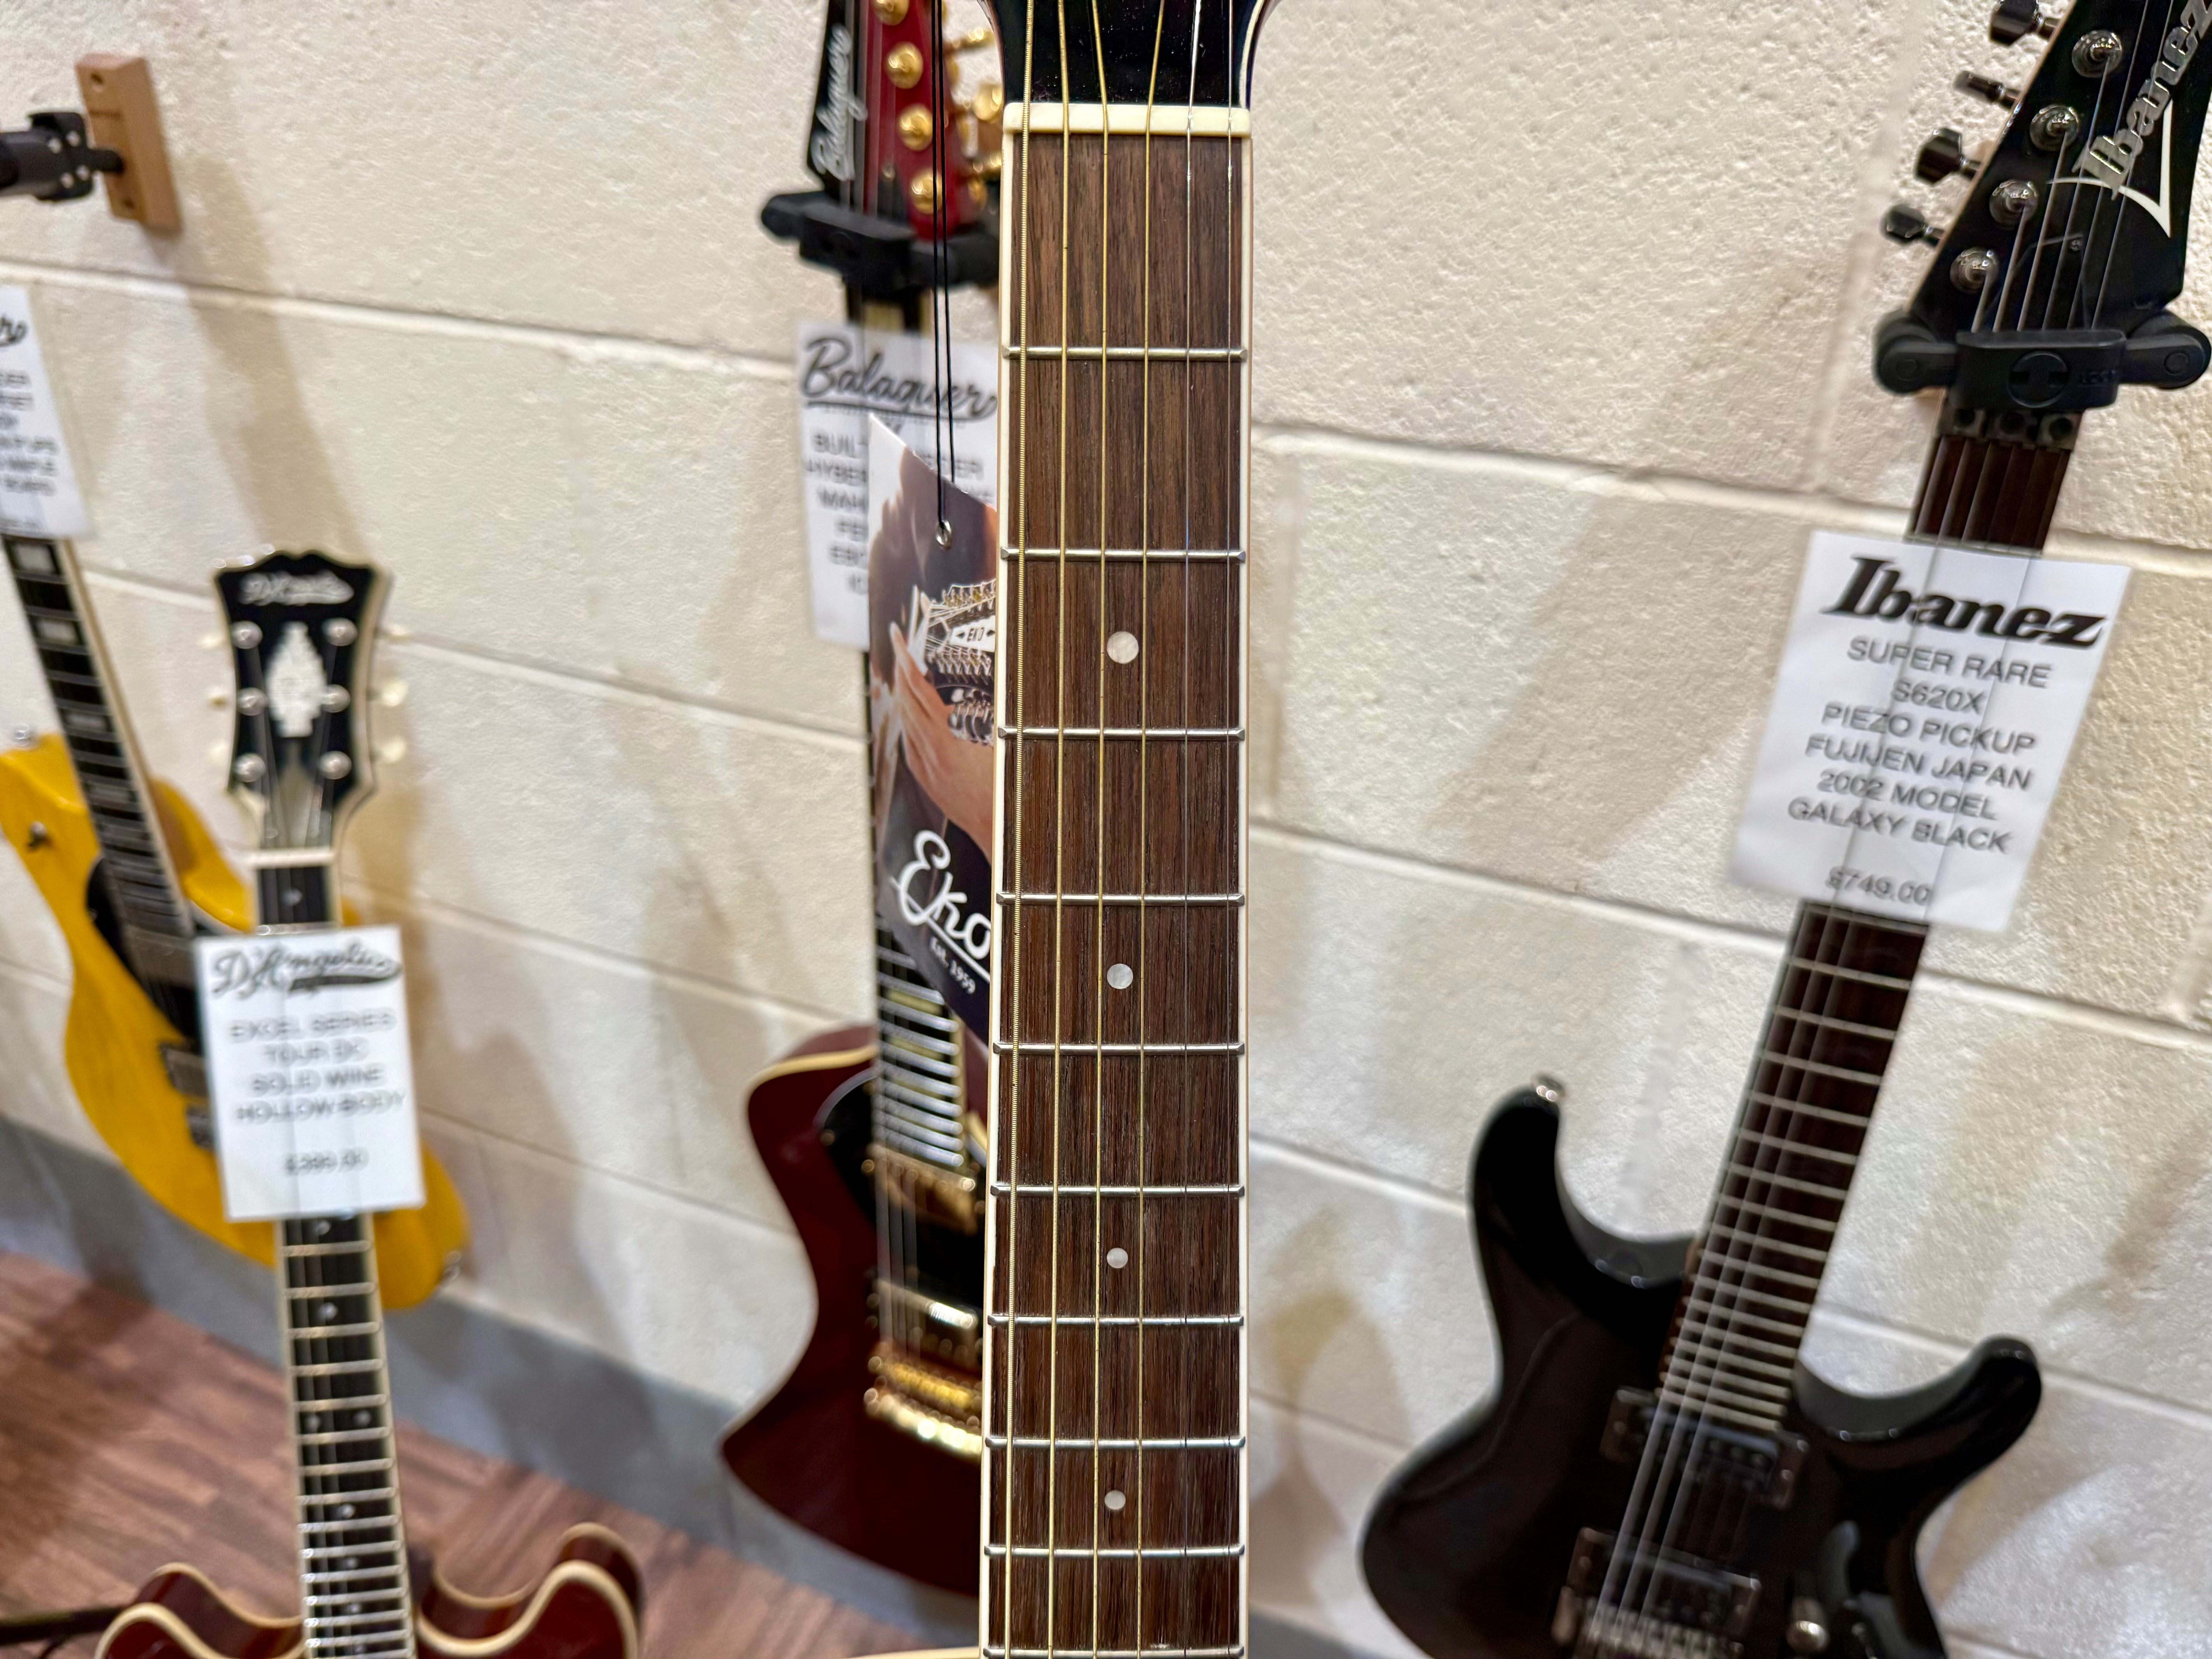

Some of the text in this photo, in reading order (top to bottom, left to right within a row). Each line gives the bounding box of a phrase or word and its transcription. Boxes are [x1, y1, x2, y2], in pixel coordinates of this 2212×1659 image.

[802, 337, 997, 421] Balaguer
[1820, 555, 2108, 650] Ibanez
[1847, 636, 2053, 689] SUPER RARE
[1891, 677, 1985, 715] S620X
[1822, 703, 2037, 756] PIEZO PICKUP
[1817, 768, 1996, 821] 2002 MODEL
[1931, 756, 2034, 792] JAPAN
[1787, 796, 2014, 854] GALAXY BLACK
[897, 830, 991, 960] Eko
[1825, 865, 1934, 906] $749.00
[309, 1008, 397, 1037] SERIES
[325, 1063, 385, 1090] WINE
